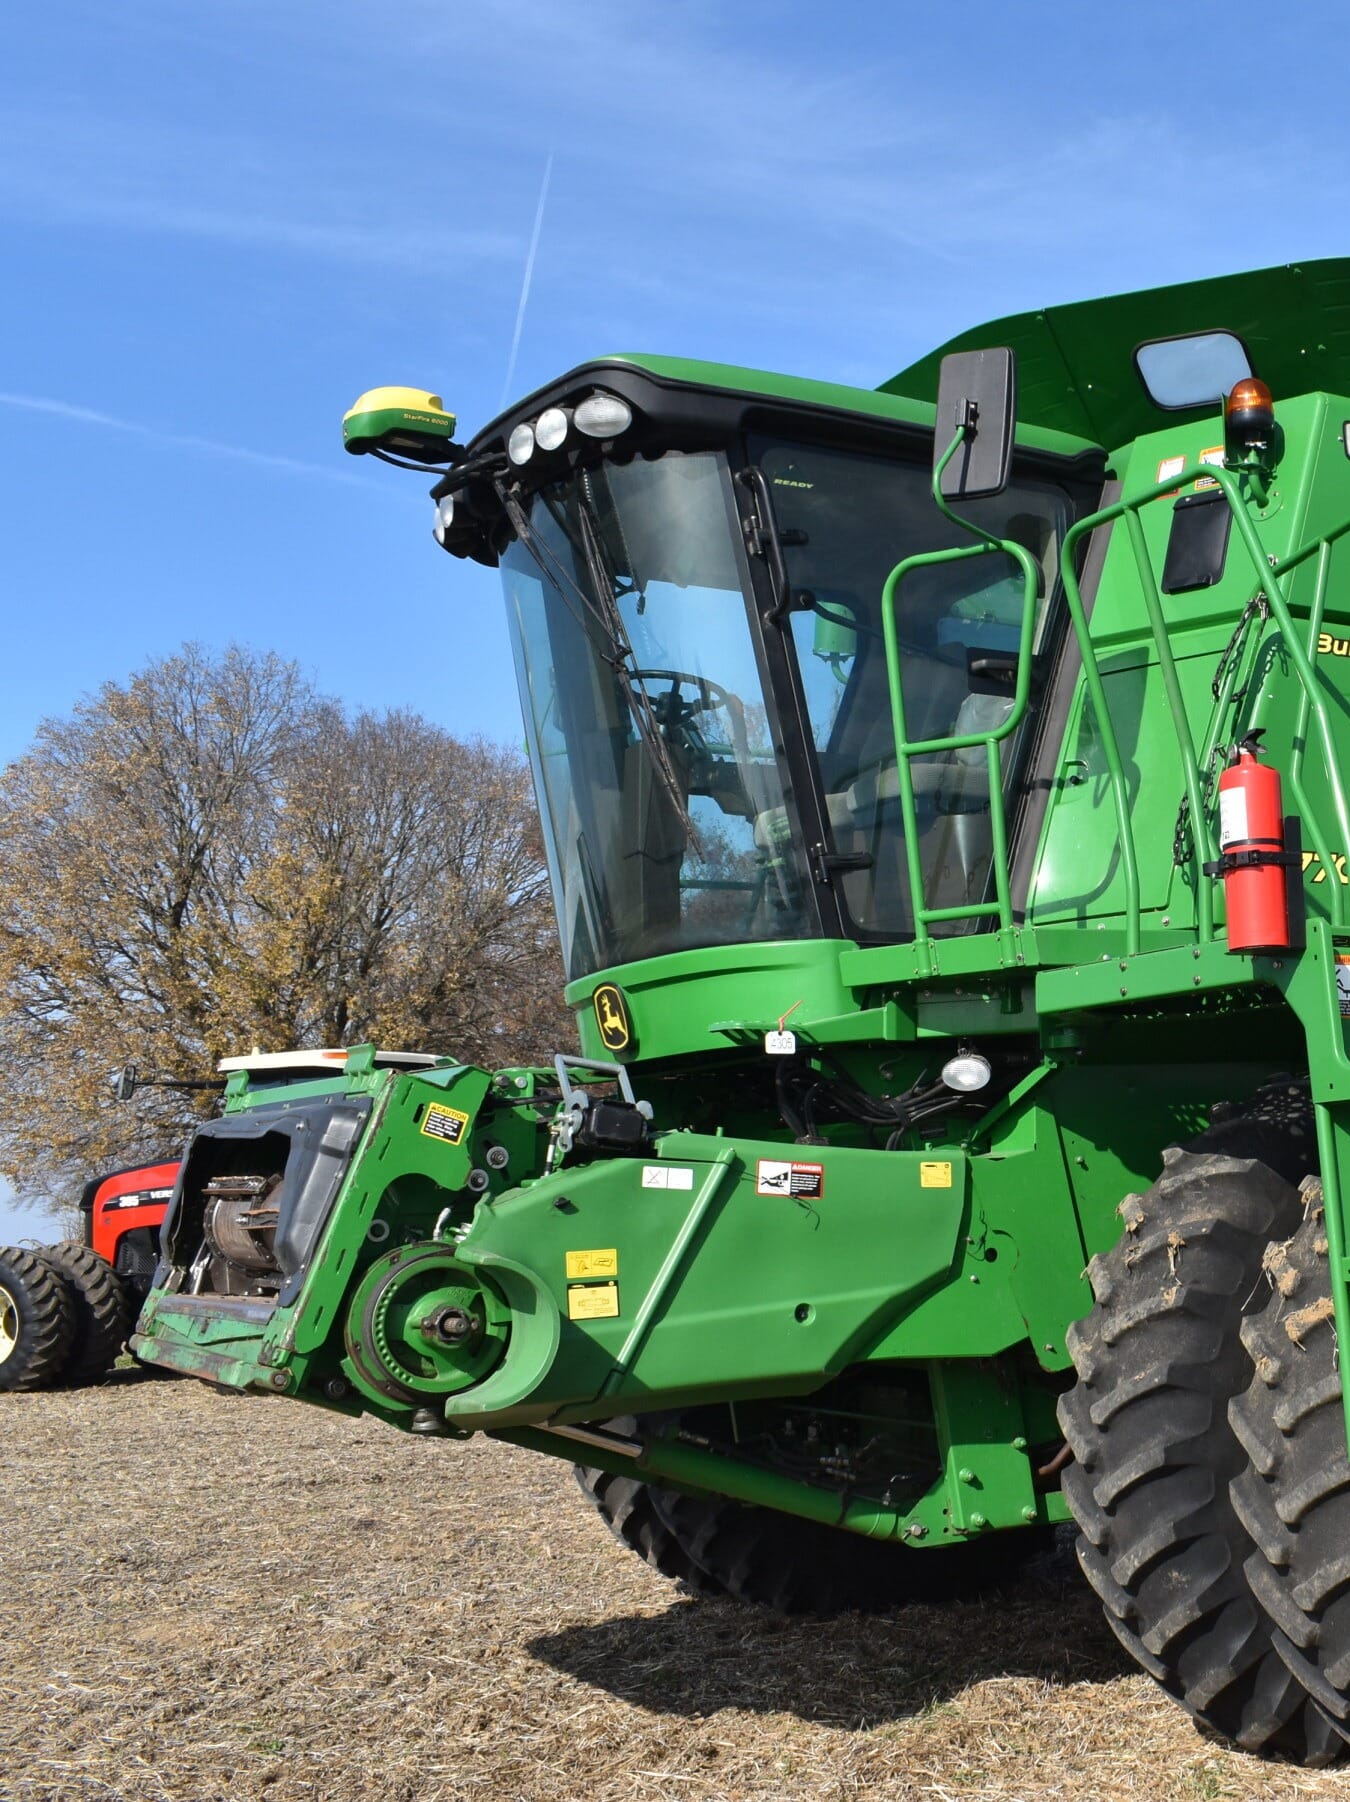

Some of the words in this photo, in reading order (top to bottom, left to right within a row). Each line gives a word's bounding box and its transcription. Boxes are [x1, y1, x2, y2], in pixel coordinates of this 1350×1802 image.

[403, 413, 430, 422] StarFire
[774, 478, 814, 488] READY
[436, 1106, 467, 1121] CAUTION
[797, 1164, 822, 1172] DANGER
